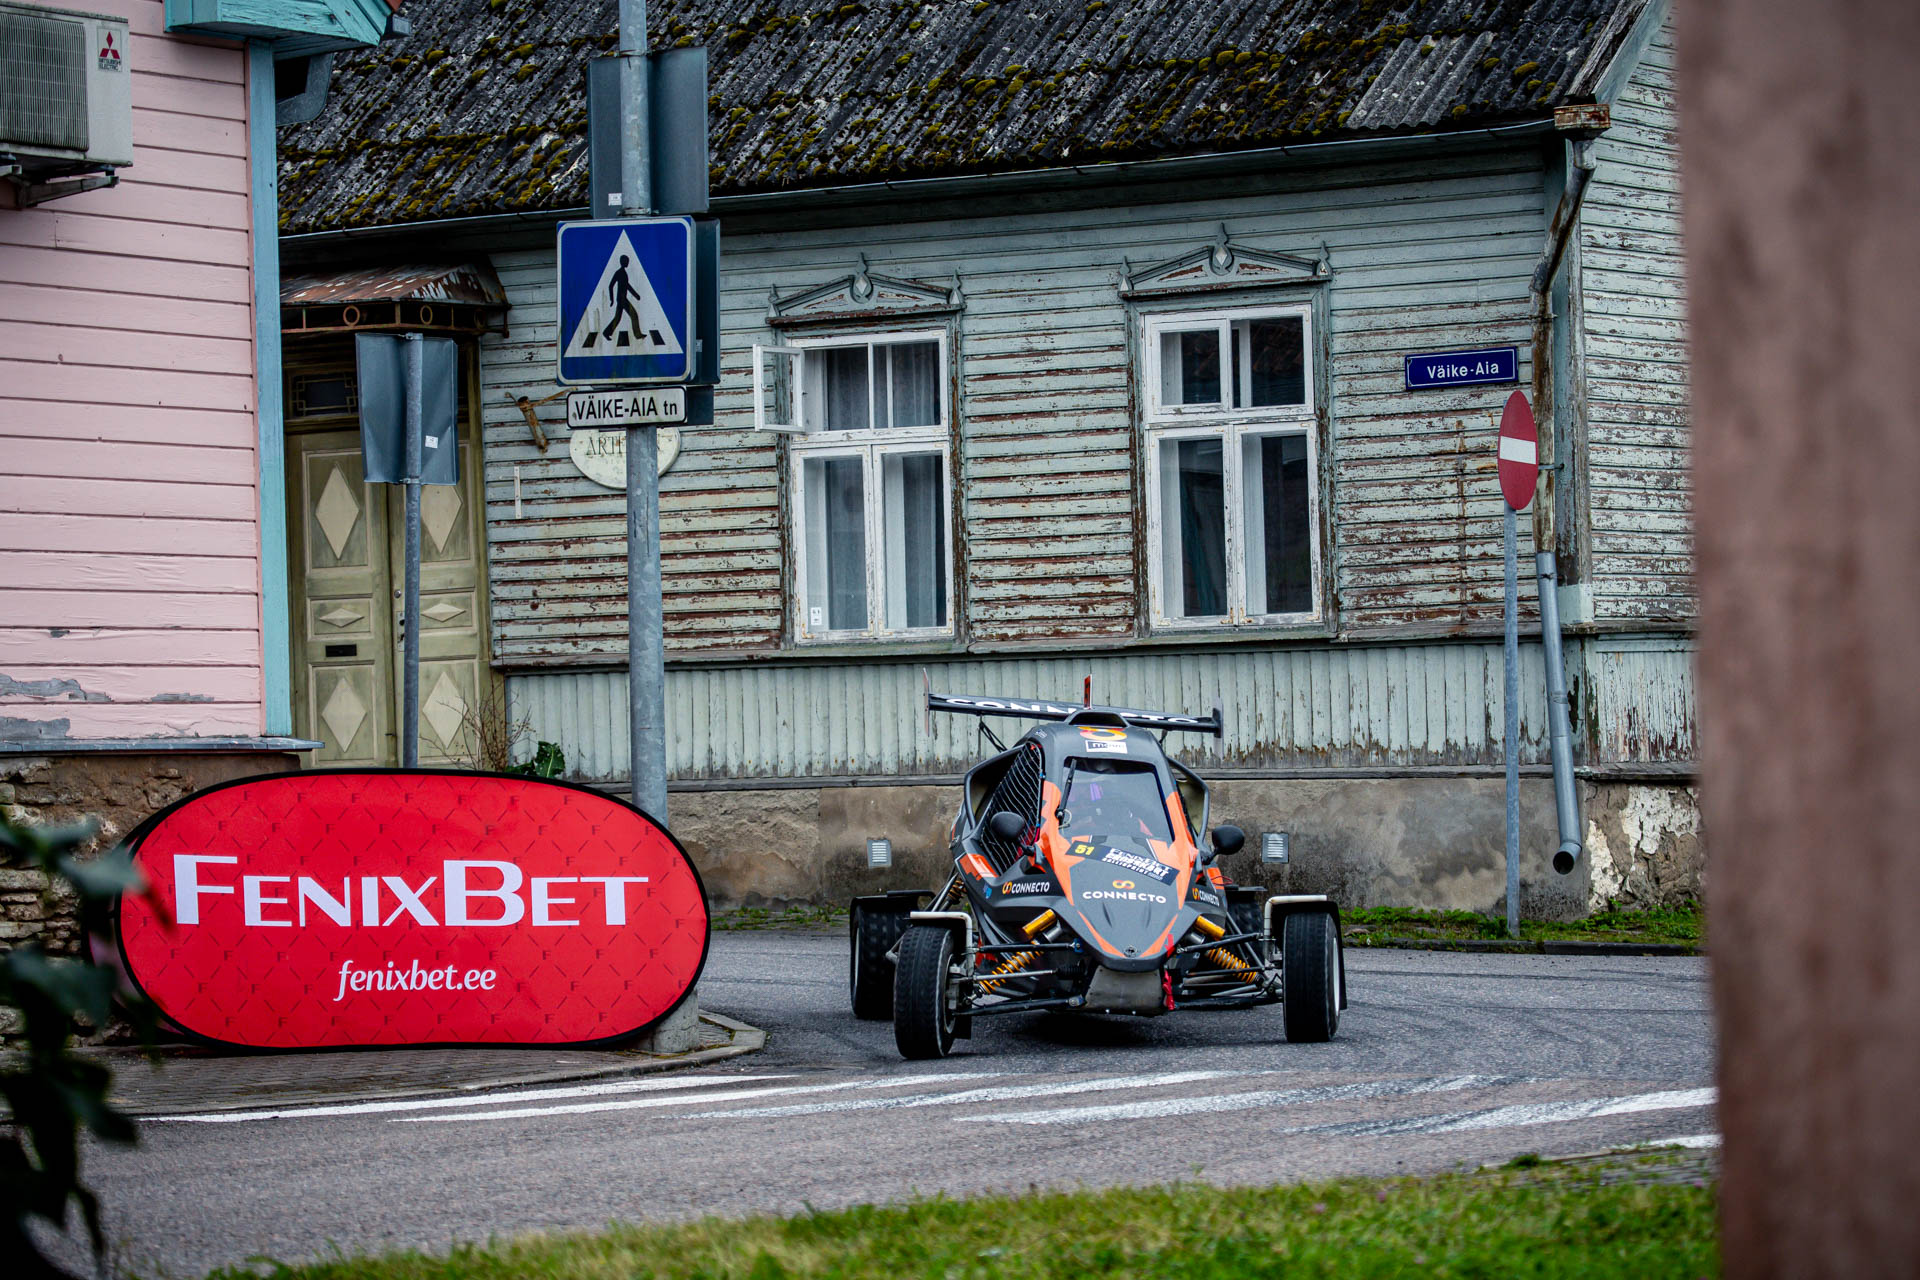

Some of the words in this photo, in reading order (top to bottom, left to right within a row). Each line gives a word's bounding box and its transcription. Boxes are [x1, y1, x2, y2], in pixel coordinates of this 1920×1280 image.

[1427, 361, 1499, 379] Väike-Aia
[575, 395, 658, 420] VÄIKE-AIA
[663, 400, 677, 415] tn
[1074, 844, 1095, 856] 51
[1011, 881, 1050, 894] CONNECTO
[1082, 890, 1167, 904] CONNECTO
[333, 959, 497, 1002] fenixbet.ee
